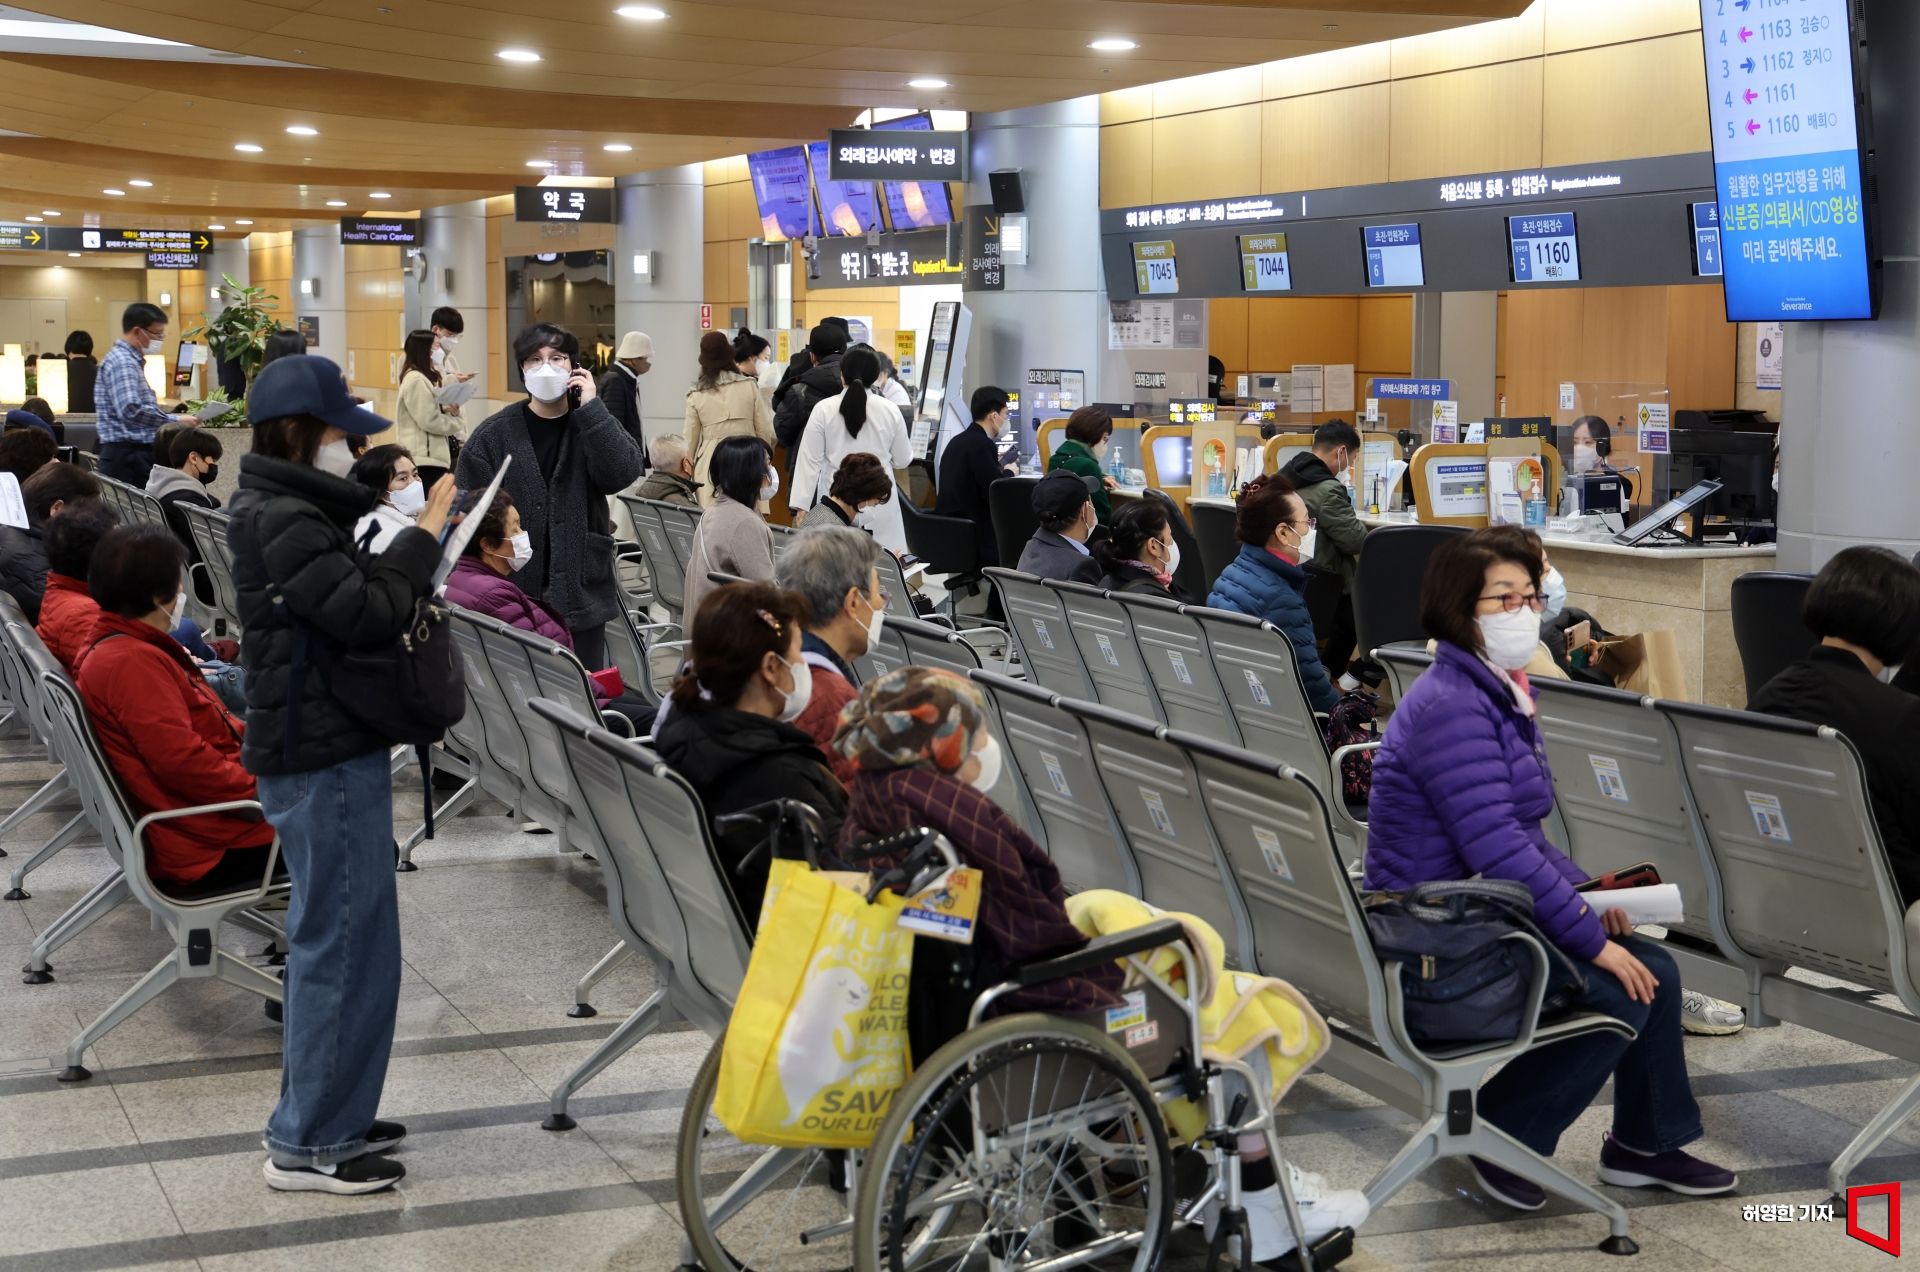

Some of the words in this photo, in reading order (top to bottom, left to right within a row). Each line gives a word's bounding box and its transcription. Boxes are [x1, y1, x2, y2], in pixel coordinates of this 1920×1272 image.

[1720, 29, 1727, 46] 4
[1761, 19, 1792, 40] 1163
[1722, 60, 1729, 78] 3
[1763, 51, 1794, 72] 1162
[1725, 91, 1732, 108] 4
[1765, 83, 1796, 103] 1161
[1728, 122, 1735, 139] 5
[1768, 114, 1800, 135] 1160
[840, 147, 916, 165] 외래검사예약
[930, 147, 955, 165] 변경
[1728, 174, 1760, 198] 원활한
[1763, 168, 1819, 195] 업무진행을
[1822, 165, 1847, 191] 위해
[1440, 180, 1482, 202] 처음오신분
[356, 223, 402, 232] International
[344, 232, 368, 241] Health
[370, 233, 387, 241] Care
[389, 233, 414, 242] Center
[984, 243, 1000, 255] 외래
[1537, 242, 1570, 264] 1160
[1706, 248, 1713, 263] 4
[1742, 239, 1765, 264] 미리
[1768, 235, 1843, 264] 준비해주세요.
[972, 257, 1000, 270] 검사예약
[1150, 263, 1171, 280] 7045
[1259, 257, 1284, 276] 7044
[1374, 264, 1379, 277] 6
[1520, 258, 1526, 271] 5
[984, 271, 1000, 285] 변경
[1781, 302, 1813, 311] Severance
[1683, 998, 1700, 1014] N
[802, 1116, 851, 1131] OUR
